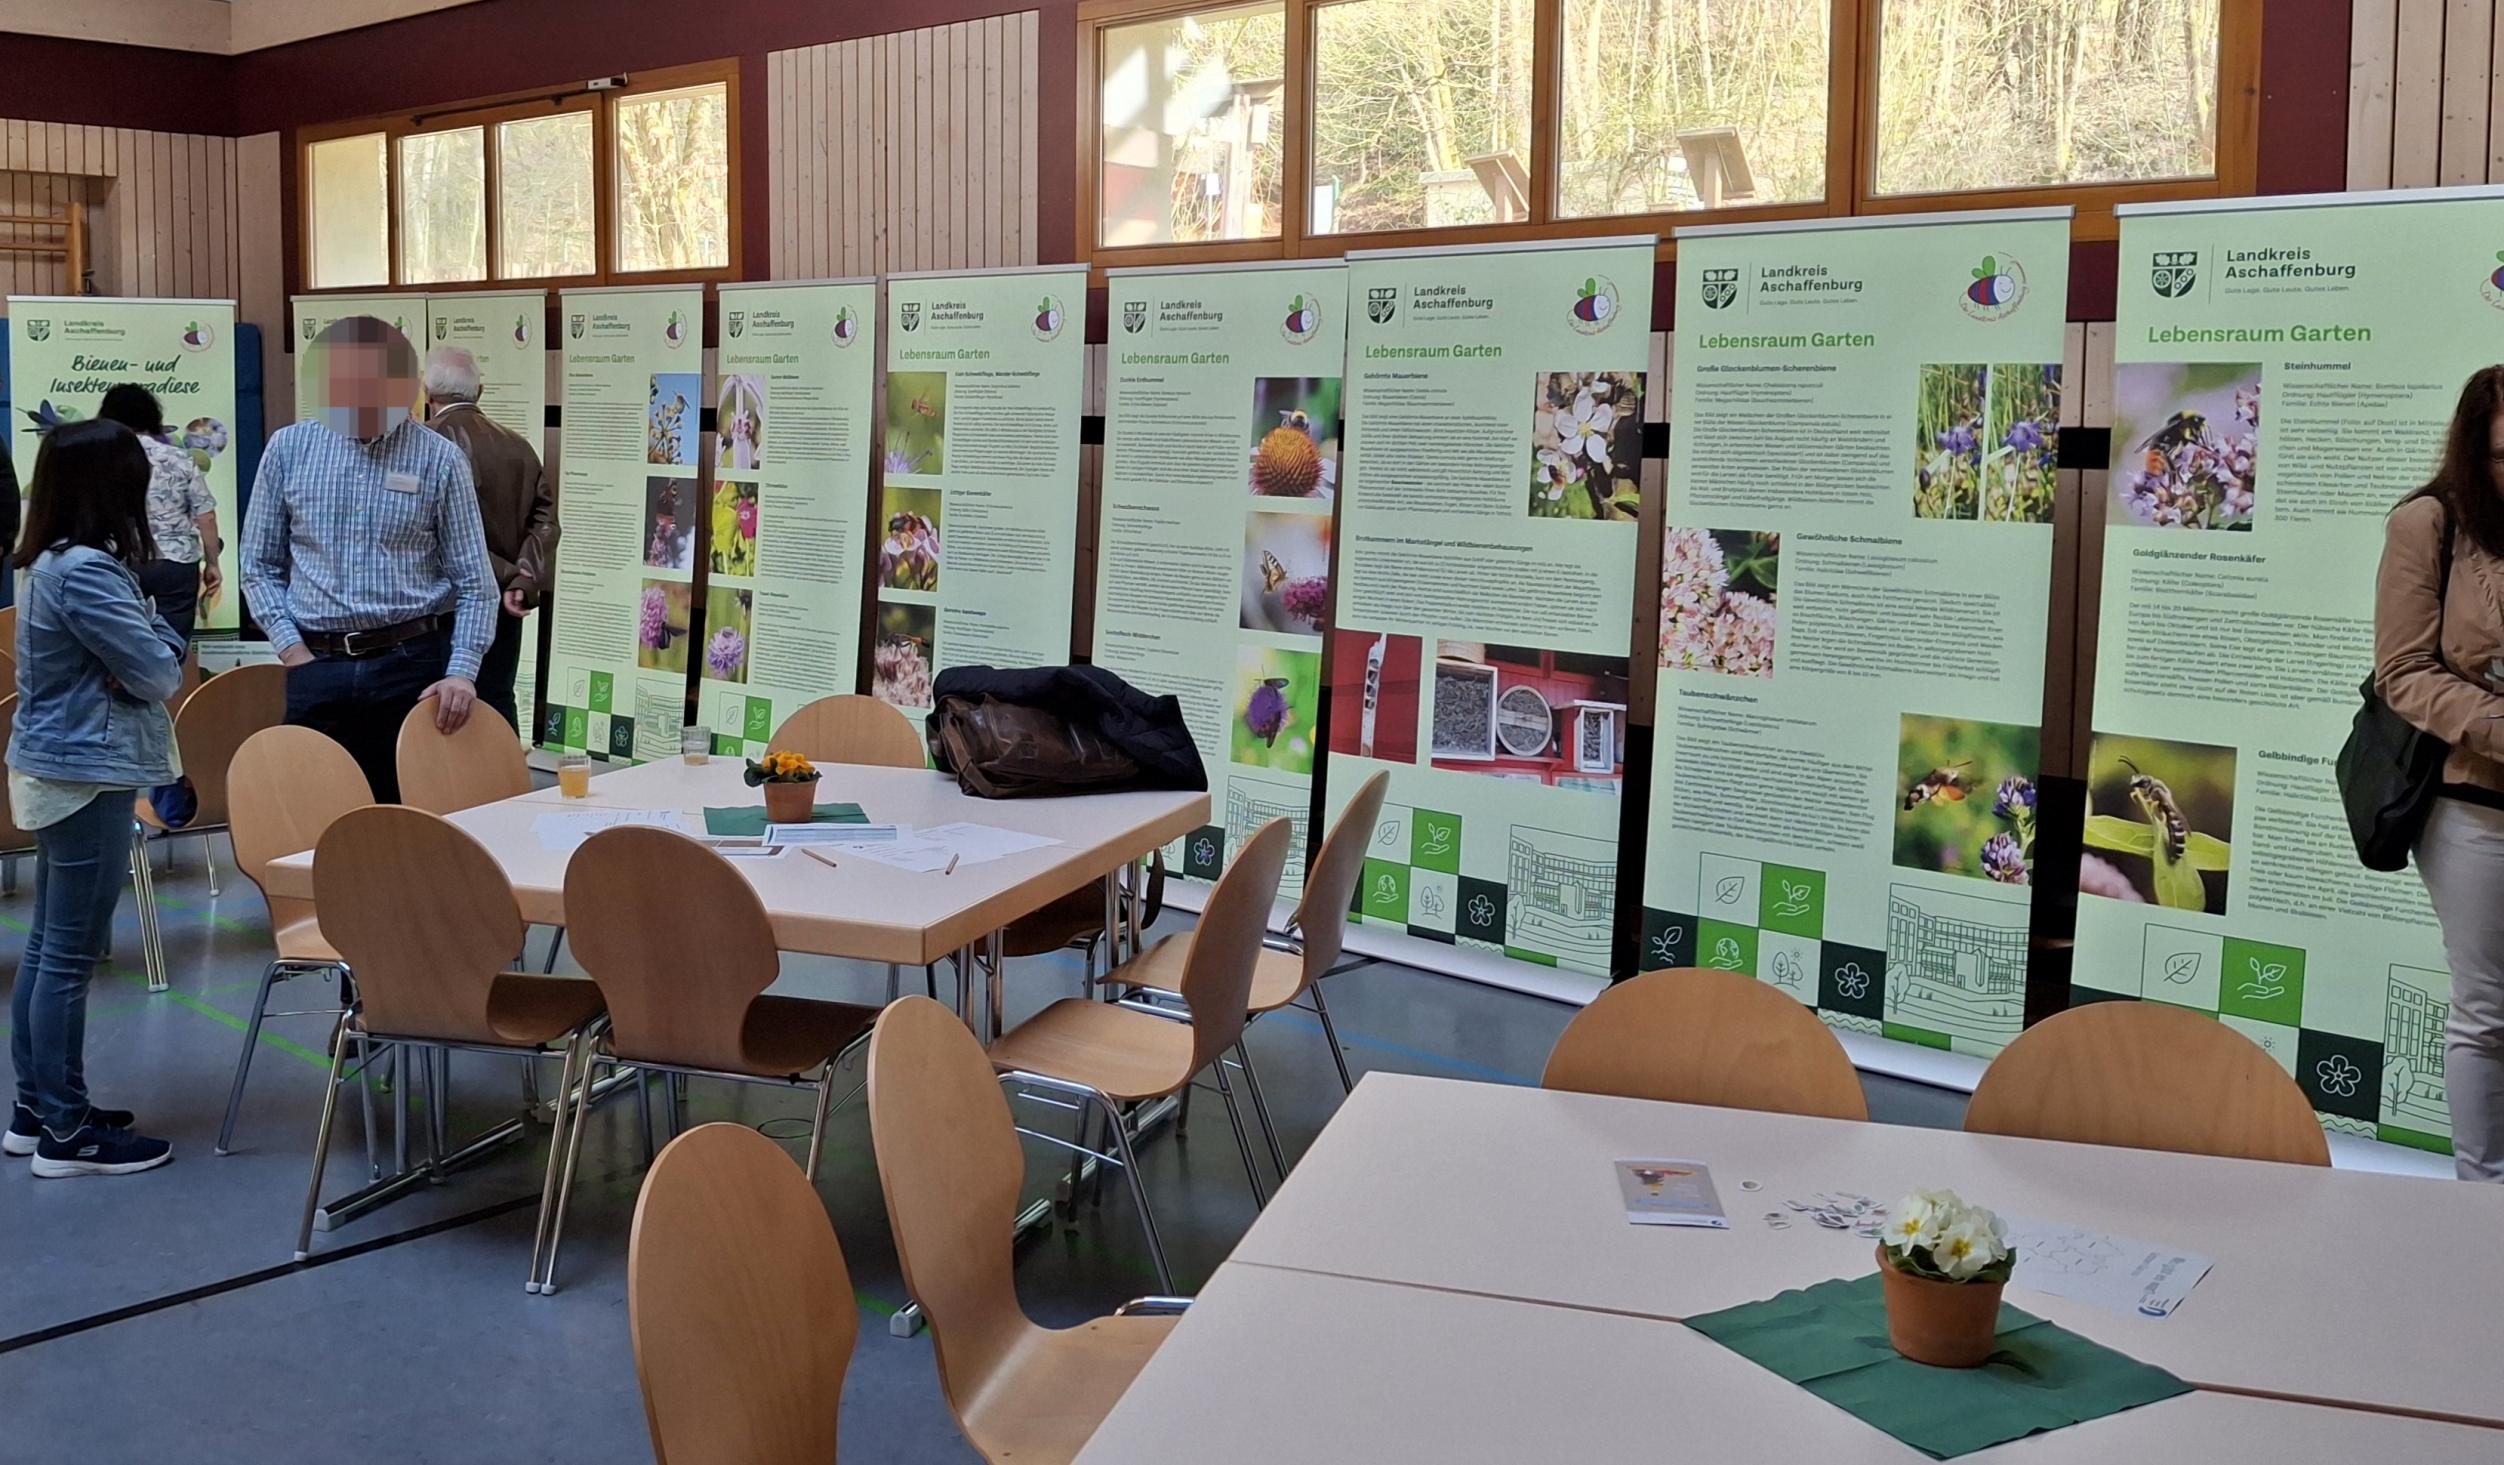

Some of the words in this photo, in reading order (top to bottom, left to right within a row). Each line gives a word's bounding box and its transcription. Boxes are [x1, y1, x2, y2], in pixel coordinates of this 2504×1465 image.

[2227, 247, 2311, 262] Landkreis
[1761, 266, 1828, 278] Landkreis
[2225, 264, 2356, 279] Aschaffenburg
[1414, 285, 1466, 296] Landkreis
[1760, 279, 1863, 293] Aschaffenburg
[1160, 300, 1201, 309] Landkreis
[1413, 298, 1493, 310] Aschaffenburg
[931, 311, 984, 321] Aschaffenburg
[1160, 311, 1222, 321] Aschaffenburg
[64, 328, 125, 336] Aschaffenburg
[2148, 325, 2284, 343] Lebensraum
[2290, 324, 2371, 342] Garten
[1699, 334, 1807, 349] Lebensraum
[1811, 332, 1875, 347] Garten
[900, 350, 956, 359] Lebensraum
[957, 349, 990, 359] Garten
[1366, 346, 1450, 358] Lebensraum
[1453, 344, 1502, 358] Garten
[72, 355, 138, 371] Bienen-
[145, 355, 181, 372] und
[612, 354, 635, 363] Garten
[727, 355, 771, 363] Lebensraum
[773, 354, 799, 363] Garten
[1121, 353, 1189, 364] Lebensraum
[1191, 352, 1229, 364] Garten
[2284, 362, 2351, 370] Steinhummel
[1797, 533, 1848, 541] Gewöhnliche
[1850, 536, 1902, 545] Schmalbiene
[2133, 548, 2208, 560] Goldglänzender
[2210, 552, 2266, 563] Rosenkäfer
[2259, 750, 2319, 765] Gelbbindige
[2322, 757, 2337, 765] Fu
